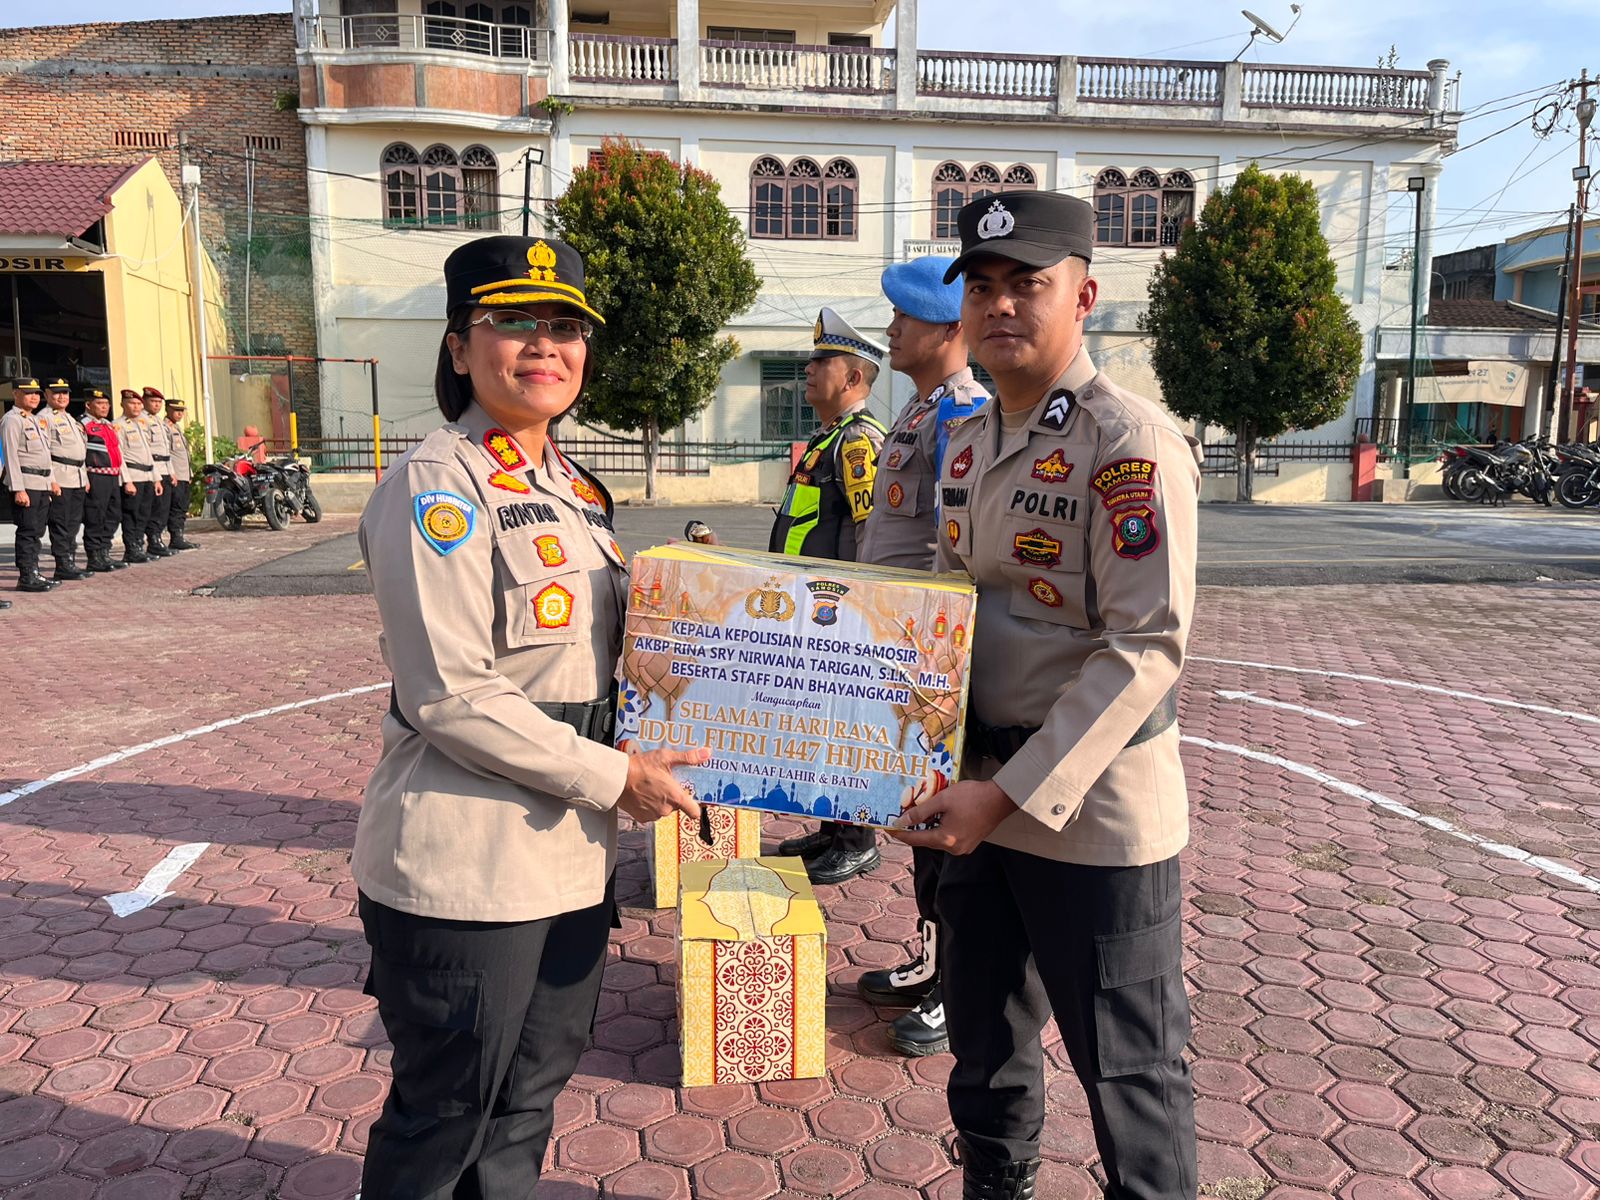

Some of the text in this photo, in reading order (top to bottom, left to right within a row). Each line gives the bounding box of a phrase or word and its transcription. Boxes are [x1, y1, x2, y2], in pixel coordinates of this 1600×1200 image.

[1094, 462, 1152, 488] POLRES
[1102, 473, 1149, 492] SAMOSIR
[420, 494, 435, 506] DIV
[1010, 489, 1078, 522] POLRI
[810, 586, 845, 595] SAMOSIR
[672, 621, 917, 664] KEPALA KEPOLISIAN RESOR SAMOSIR
[635, 637, 670, 653] AKBP
[673, 642, 706, 658] RINA
[710, 647, 735, 662] SRY
[738, 651, 806, 671] NIRWANA
[810, 658, 875, 681] TARIGAN,
[918, 673, 951, 690] M.H.
[671, 662, 910, 704] BESERTA STAFF DAN BHAYANGKARI
[750, 691, 822, 711] Mengucapkan
[679, 701, 891, 745] SELAMAT HARI RAYA
[638, 718, 930, 778] IDUL FITRI 1447 HIJRIAH
[741, 760, 777, 777] MAAF
[778, 766, 816, 783] LAHIR
[818, 772, 829, 785] &
[831, 774, 870, 790] BATIN
